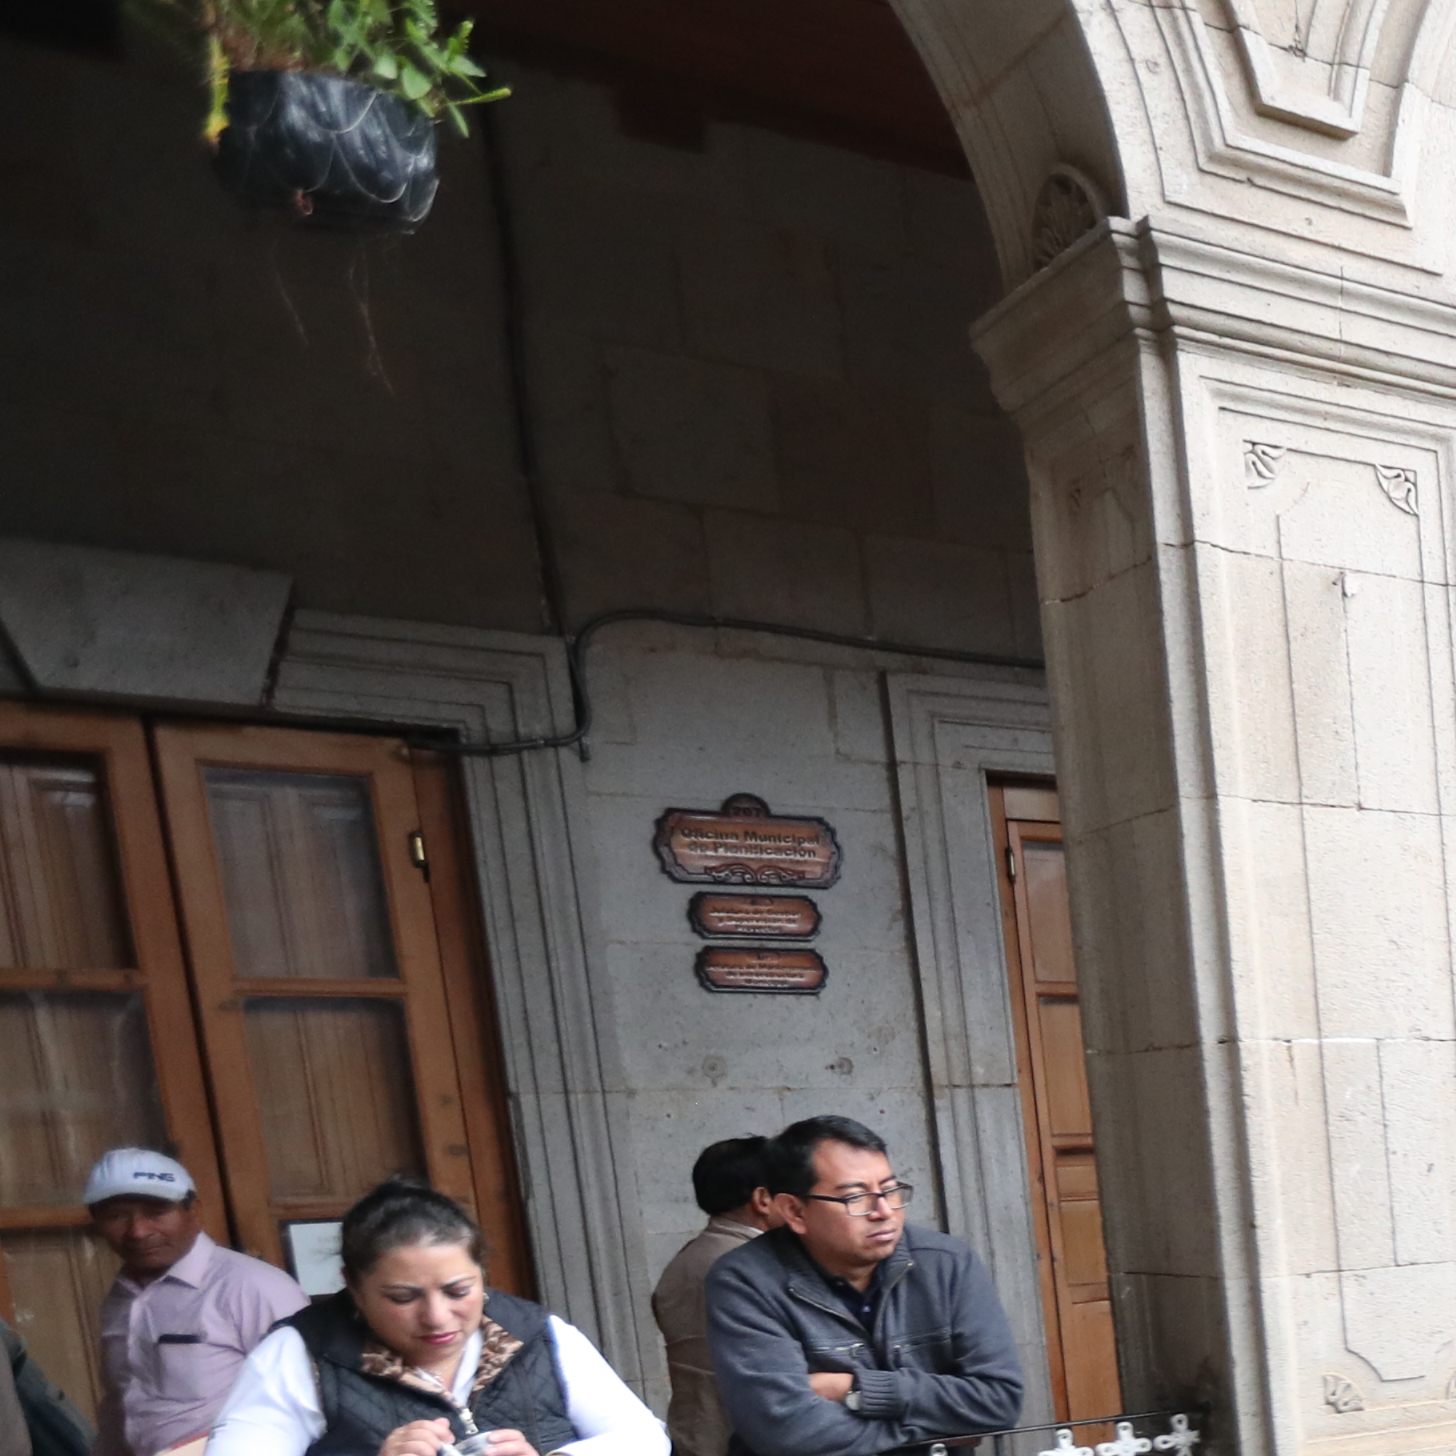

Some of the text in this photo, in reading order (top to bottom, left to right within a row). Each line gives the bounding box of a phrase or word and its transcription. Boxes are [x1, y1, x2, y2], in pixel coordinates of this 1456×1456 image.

[680, 828, 820, 846] Oficina Municipal
[689, 841, 816, 857] de Planificación
